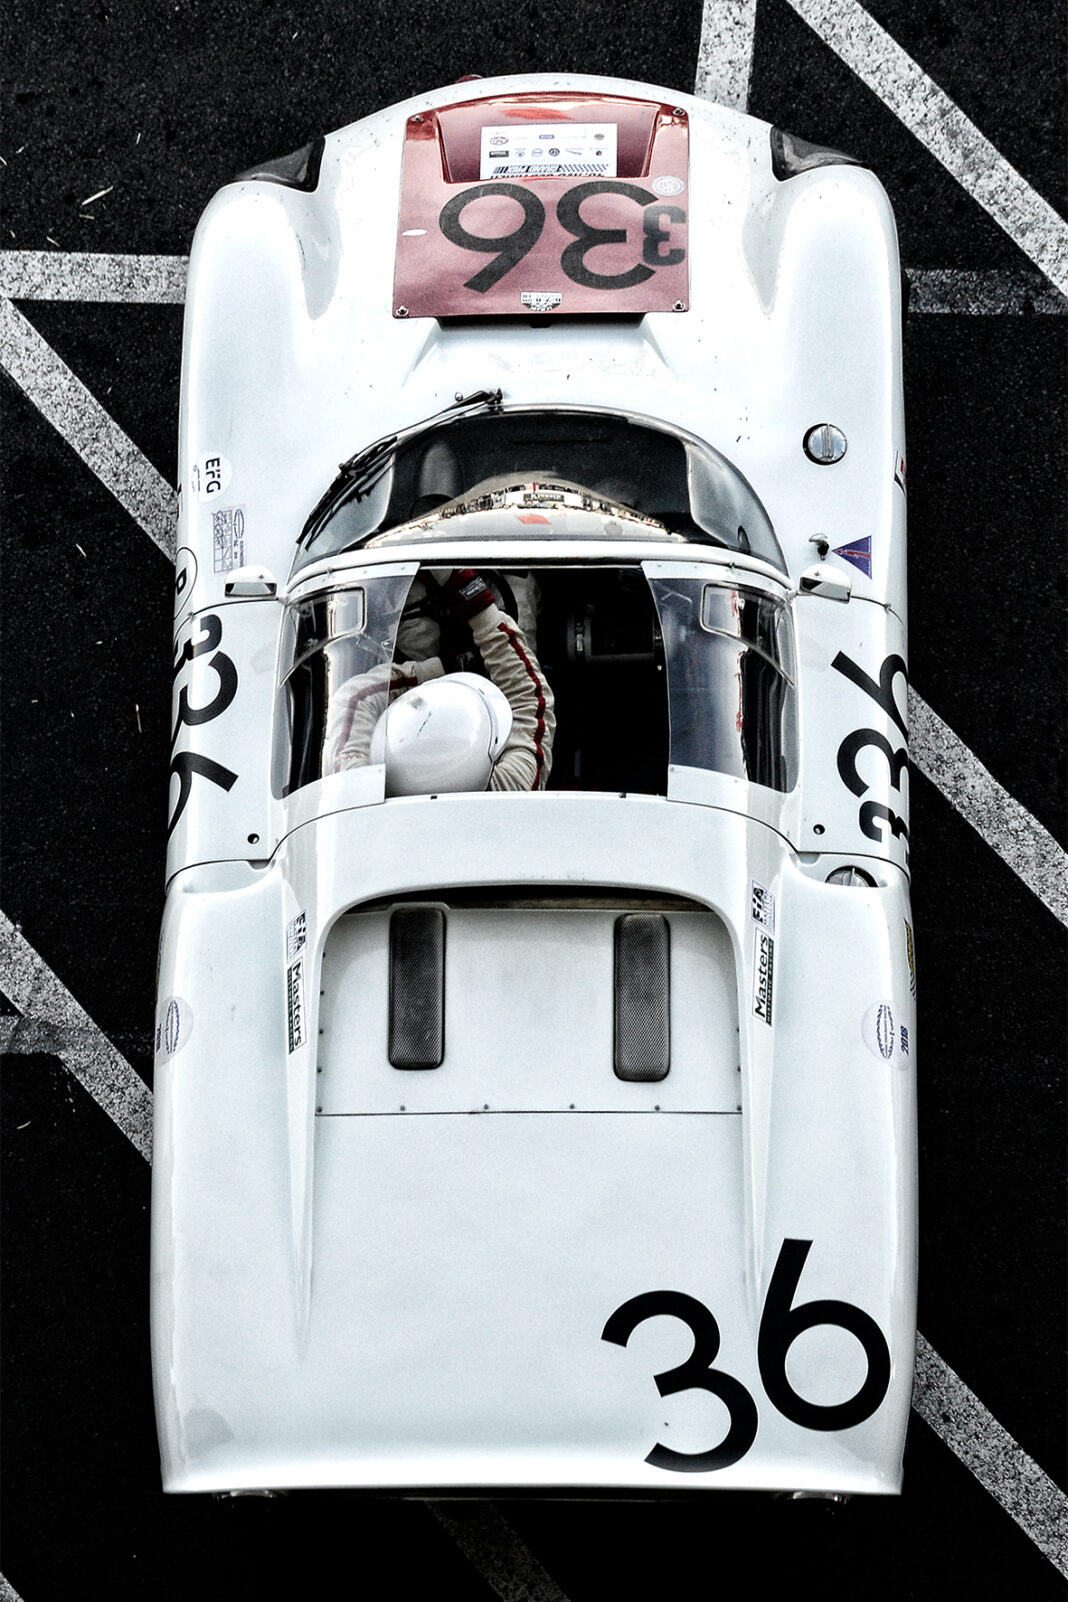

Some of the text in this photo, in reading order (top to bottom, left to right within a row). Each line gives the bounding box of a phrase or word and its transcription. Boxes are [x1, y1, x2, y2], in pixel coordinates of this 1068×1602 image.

[439, 181, 659, 293] 36
[642, 205, 687, 266] 3
[292, 962, 302, 1047] Masters
[755, 935, 768, 1018] Masters
[601, 1238, 891, 1473] 36
